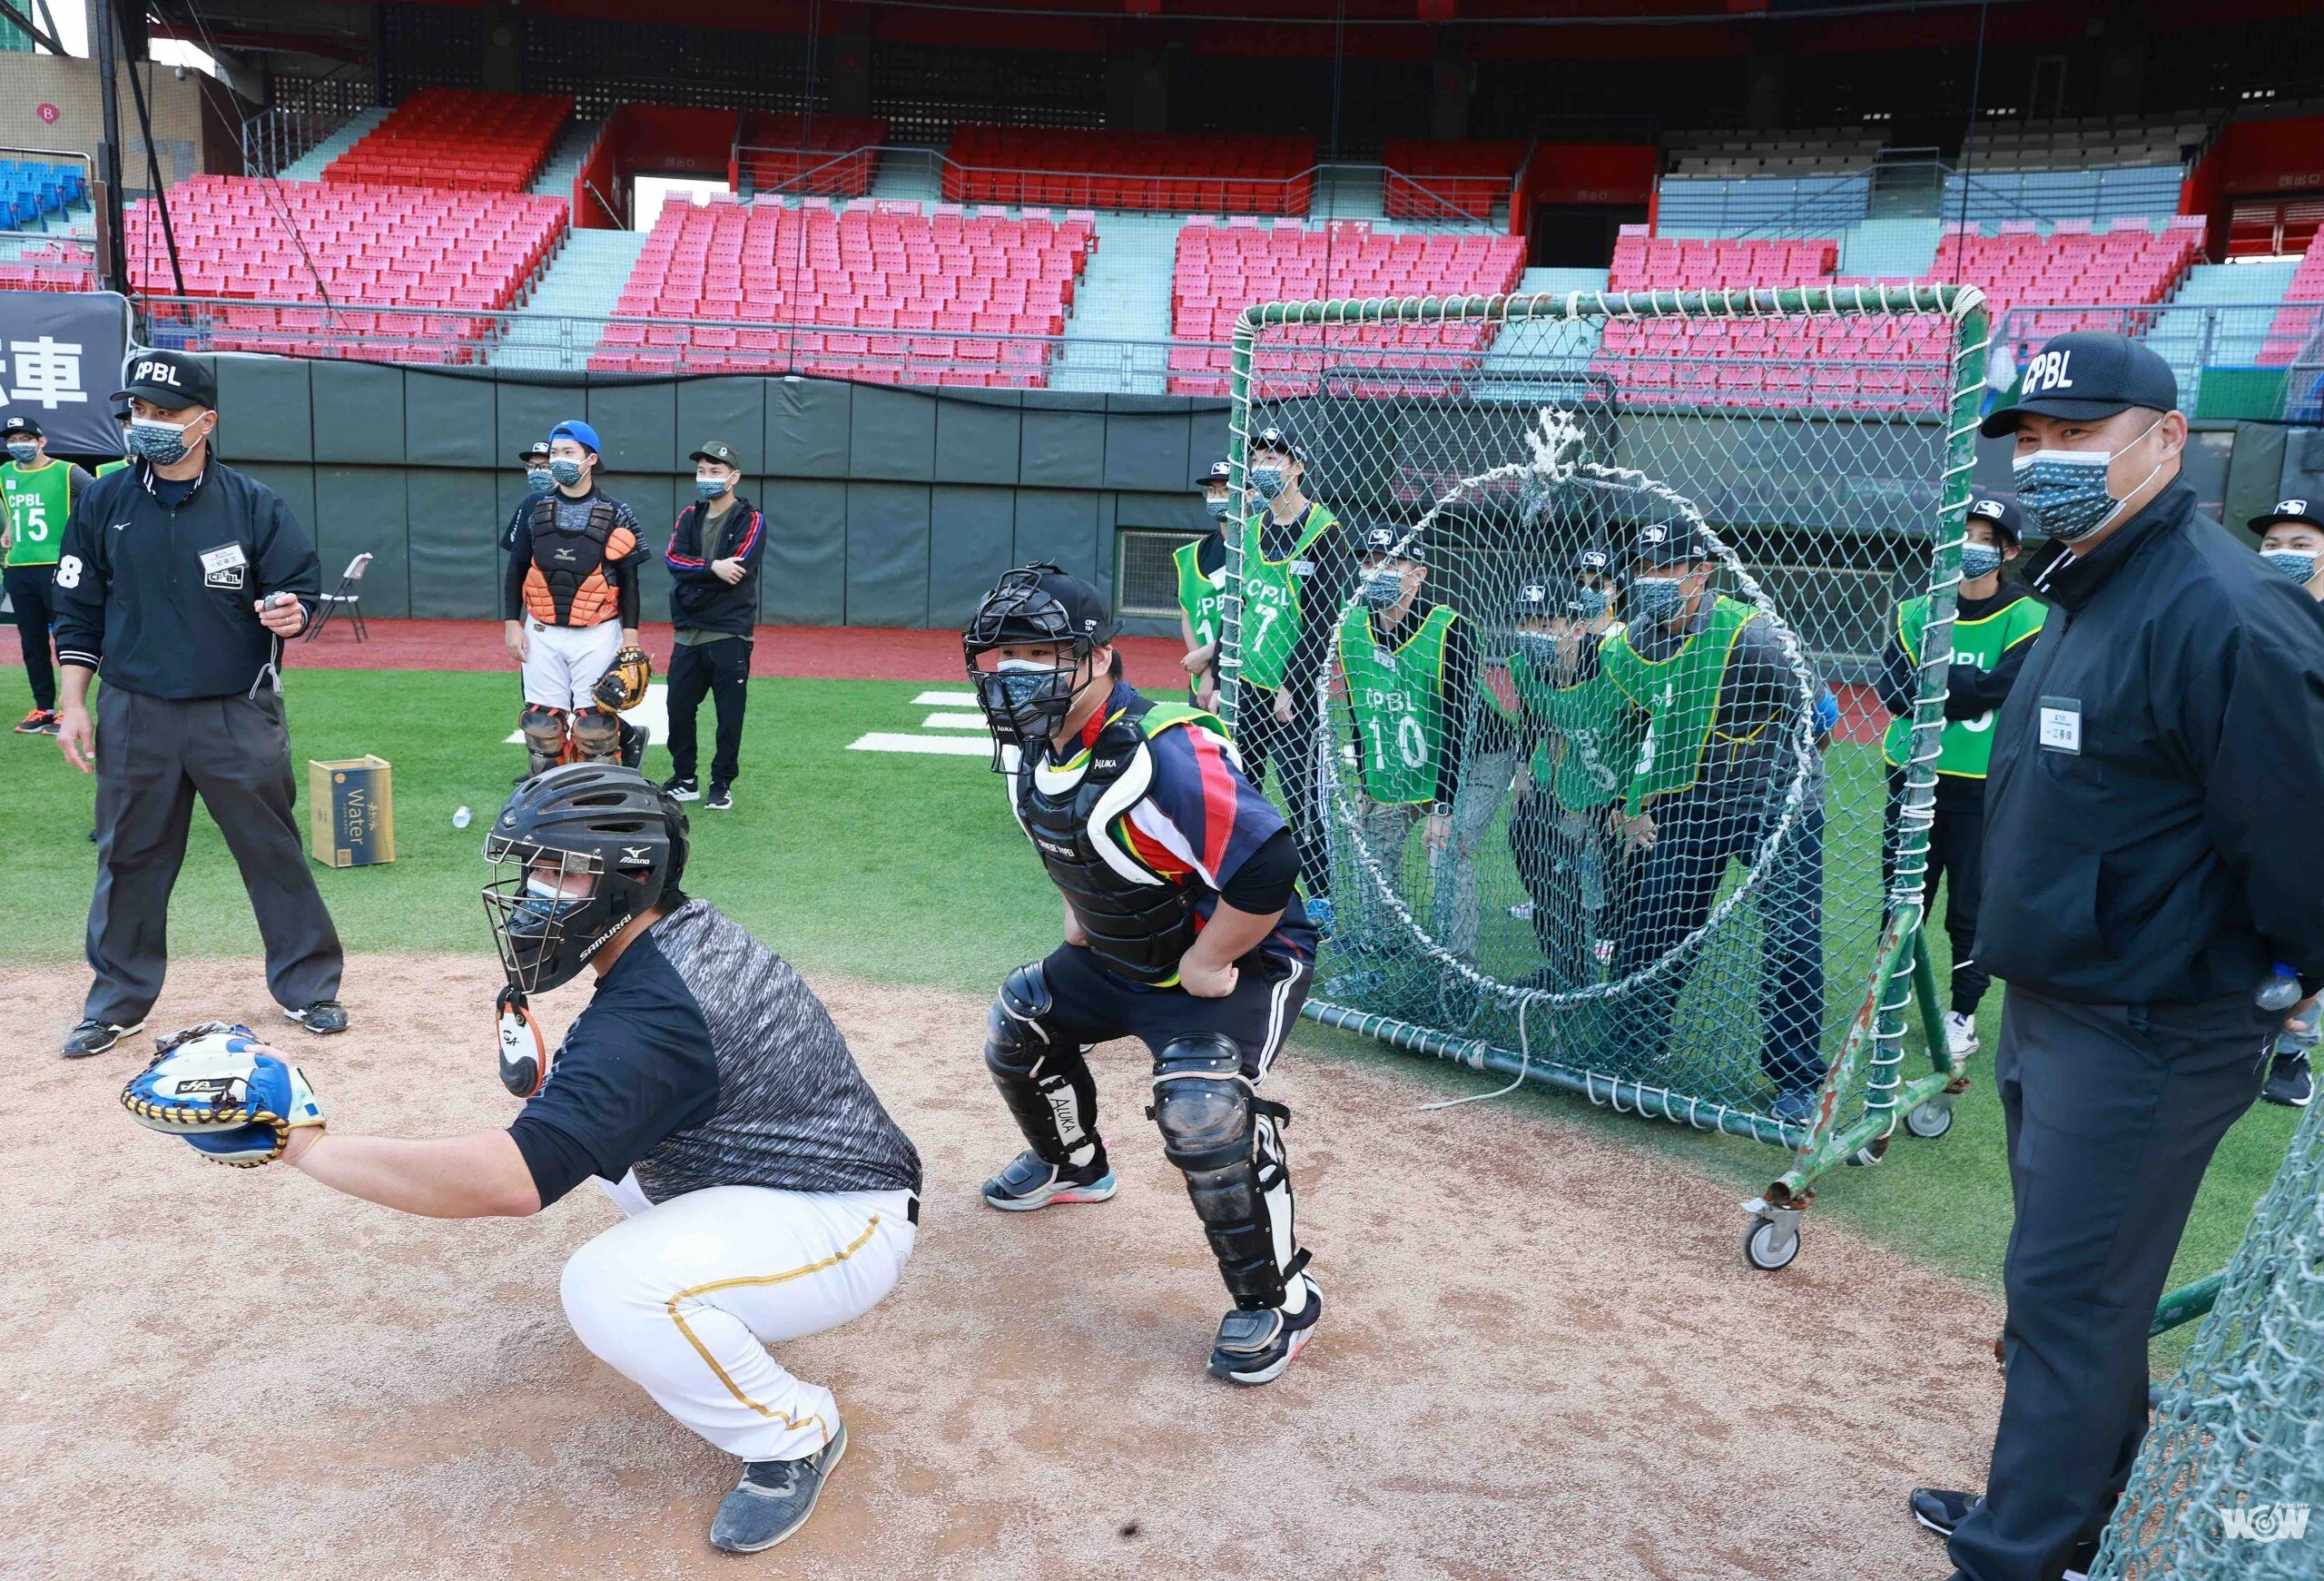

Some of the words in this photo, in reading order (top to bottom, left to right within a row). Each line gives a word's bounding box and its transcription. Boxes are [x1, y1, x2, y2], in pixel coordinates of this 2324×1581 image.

[44, 107, 54, 119] B
[0, 336, 87, 409] 車
[134, 361, 182, 388] CPBL
[2022, 350, 2073, 395] CPBL
[8, 493, 45, 509] CPBL
[12, 508, 48, 542] 15
[1254, 603, 1278, 652] 7
[1365, 687, 1417, 712] CPBL
[1368, 715, 1429, 770] 10
[1094, 758, 1118, 770] ALUKA
[348, 788, 365, 845] Water
[579, 913, 633, 963] SAMURAI
[1049, 1098, 1078, 1134] ALUKA
